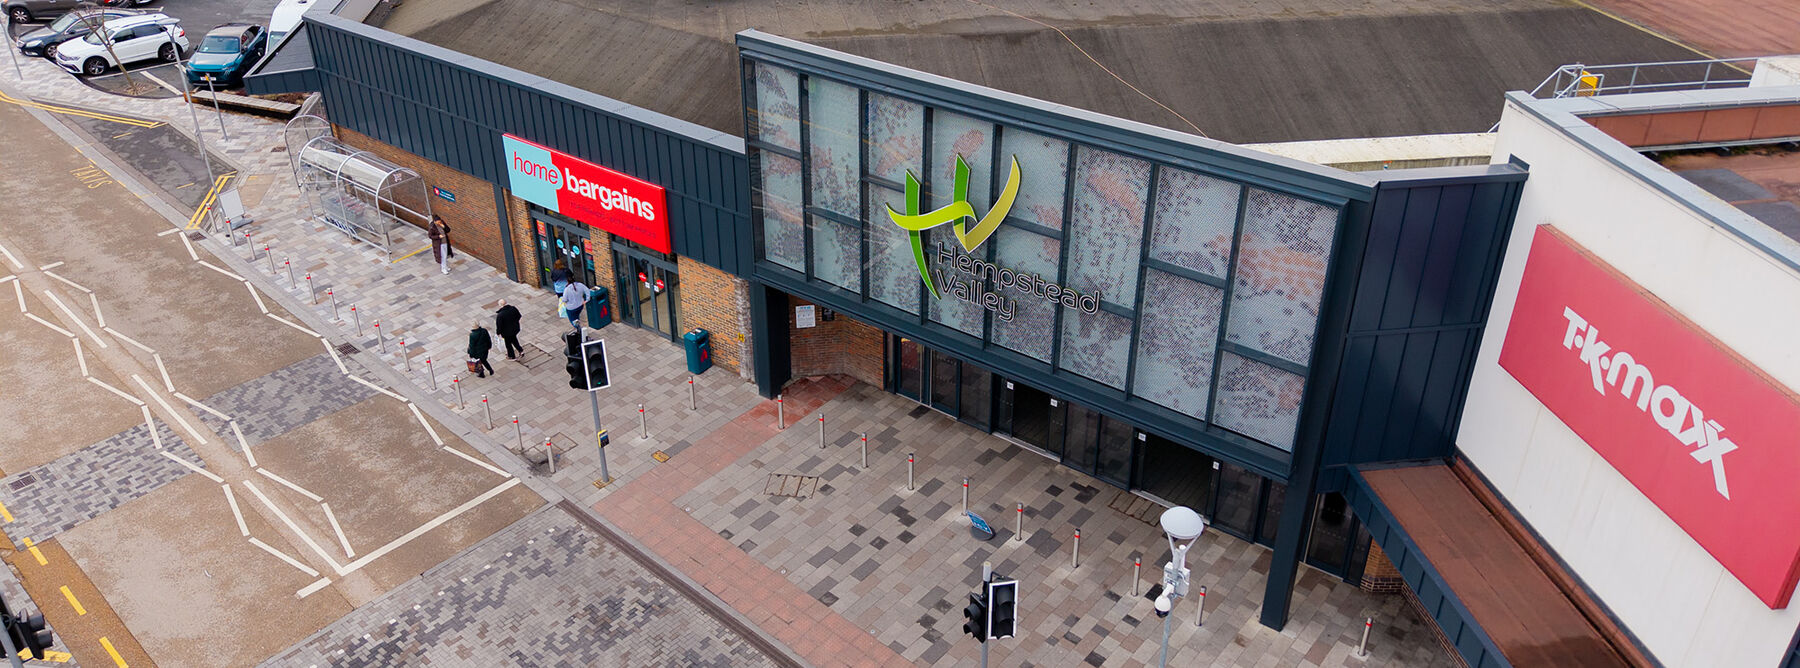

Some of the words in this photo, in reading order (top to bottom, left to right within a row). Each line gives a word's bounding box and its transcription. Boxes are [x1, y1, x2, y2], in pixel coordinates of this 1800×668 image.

[69, 164, 113, 189] TAXIS
[513, 151, 558, 185] home
[564, 168, 655, 221] bargains
[936, 269, 1016, 322] Valley
[937, 241, 1100, 315] Hempstead
